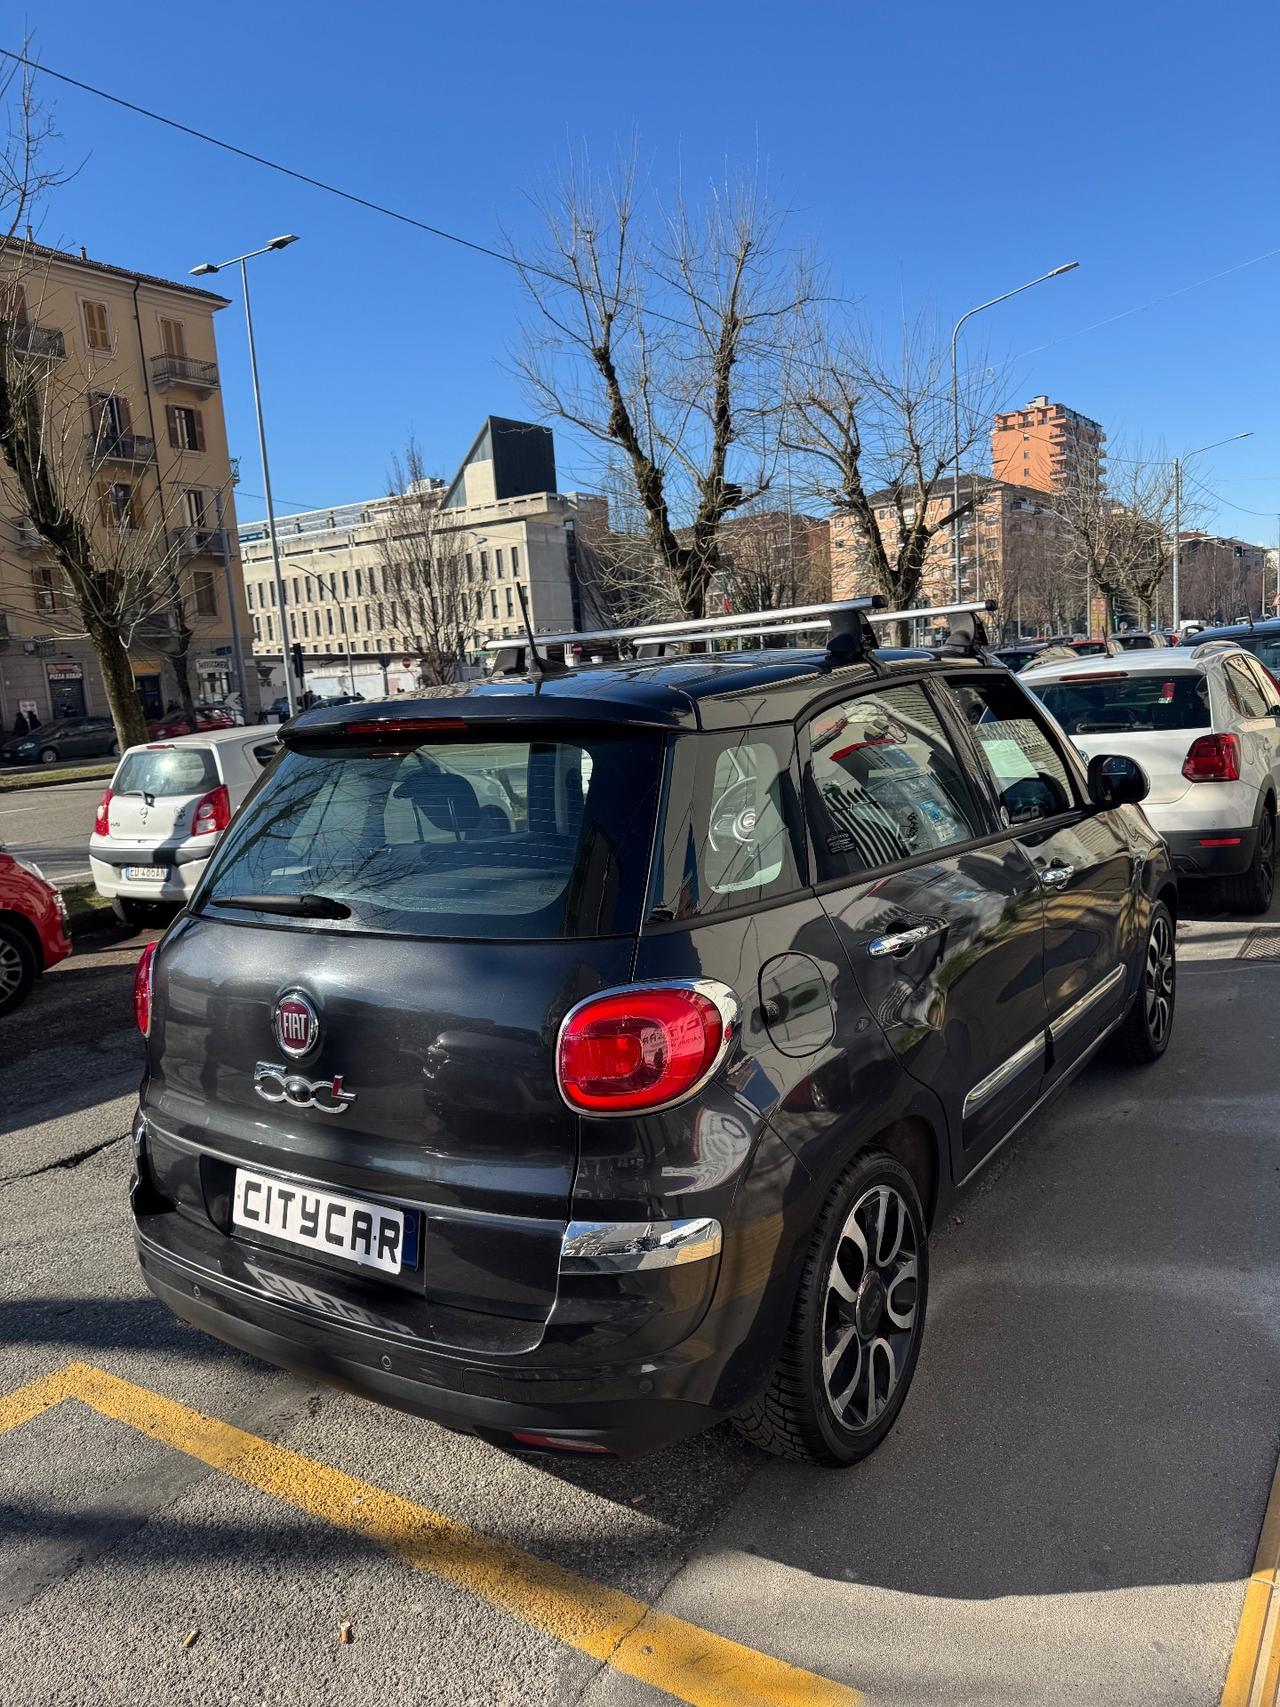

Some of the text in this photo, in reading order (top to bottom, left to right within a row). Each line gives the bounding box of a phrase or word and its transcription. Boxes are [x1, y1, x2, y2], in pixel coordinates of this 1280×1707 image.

[49, 672, 65, 680] PIZZA
[283, 1012, 307, 1040] FIAT
[243, 1180, 401, 1265] CITYCAR
